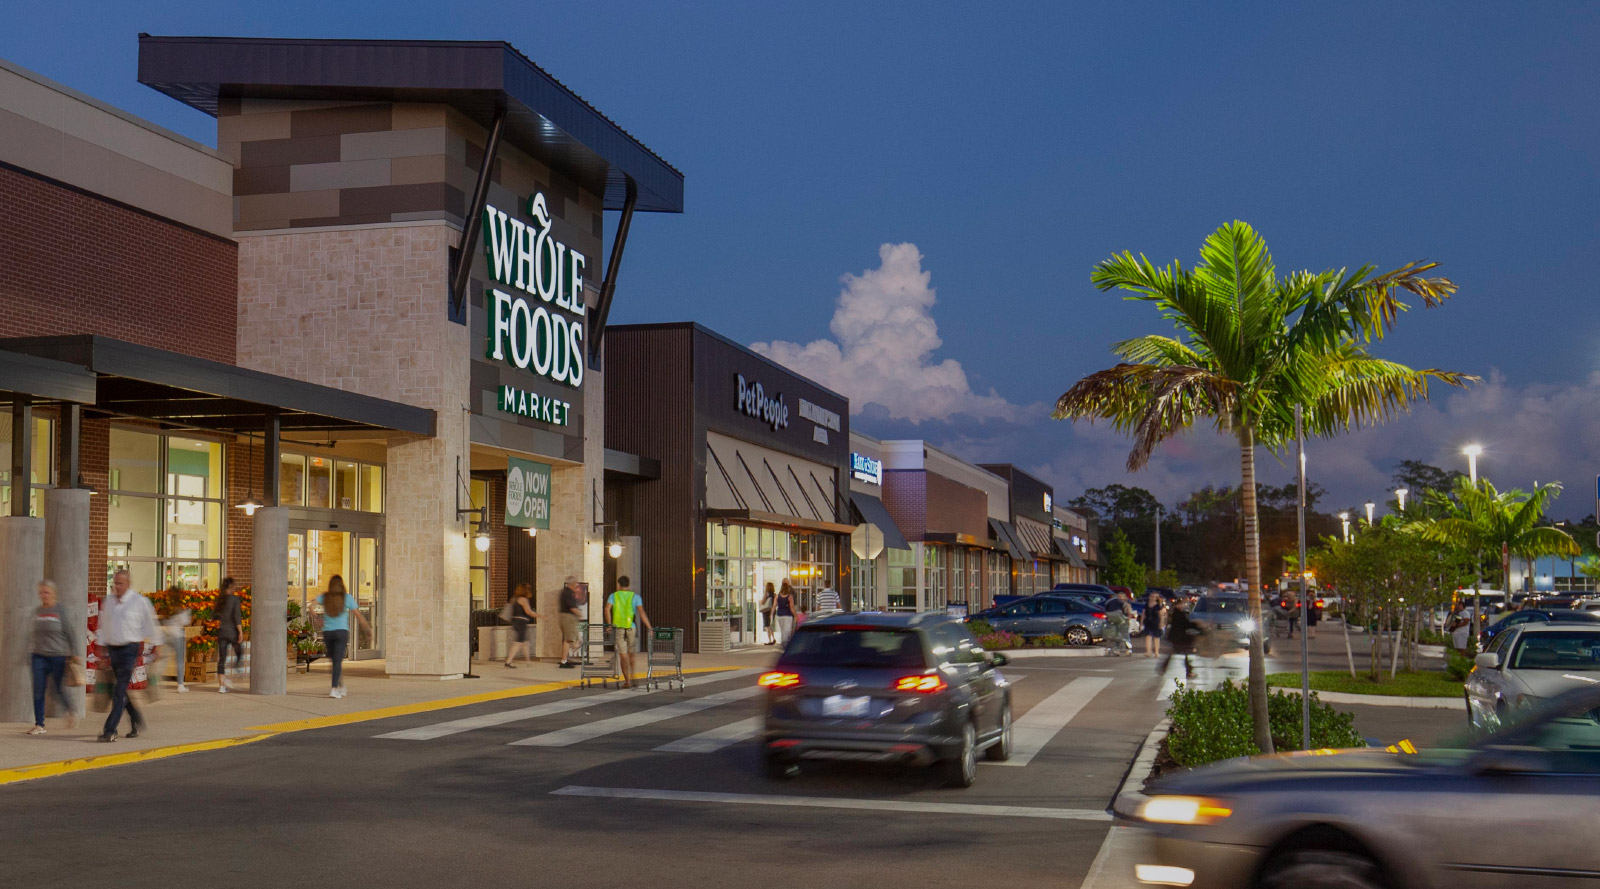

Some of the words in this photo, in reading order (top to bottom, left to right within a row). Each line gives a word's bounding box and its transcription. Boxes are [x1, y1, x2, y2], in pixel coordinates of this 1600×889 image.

[485, 202, 585, 316] WHOLE
[491, 288, 584, 388] FOODS
[503, 384, 570, 427] MARKET
[737, 373, 789, 431] PetPeople
[523, 495, 548, 520] OPEN
[526, 471, 549, 495] NOW
